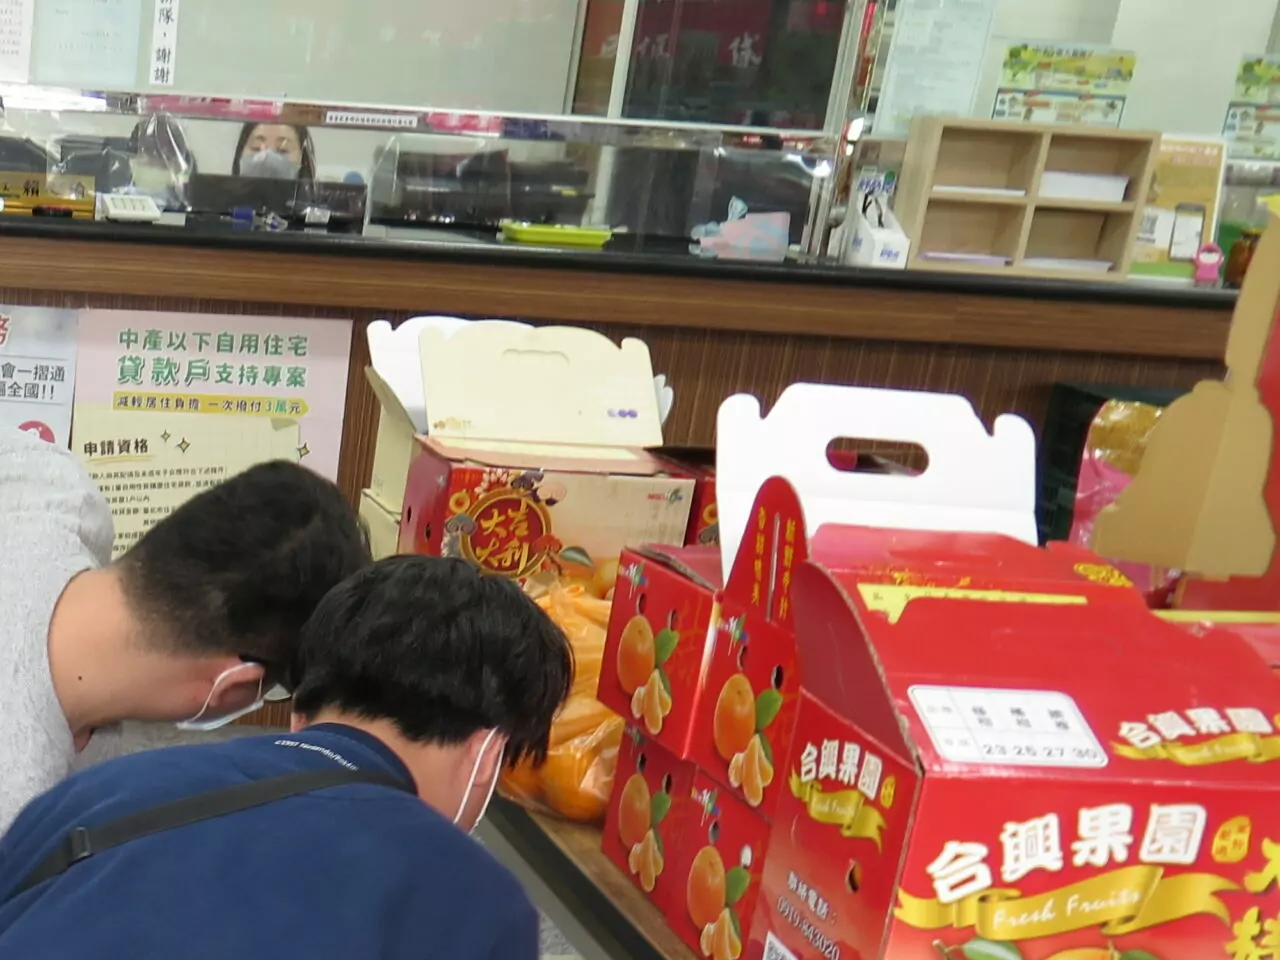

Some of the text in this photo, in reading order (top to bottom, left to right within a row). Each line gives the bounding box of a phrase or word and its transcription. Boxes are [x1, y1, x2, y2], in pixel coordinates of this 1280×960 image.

[119, 328, 308, 357] 中產以下自用住宅
[117, 355, 307, 388] 貸款戶支持專案
[83, 438, 149, 457] 申請資格
[926, 803, 1207, 903] 合興果園
[993, 888, 1142, 930] Fresh Fruits
